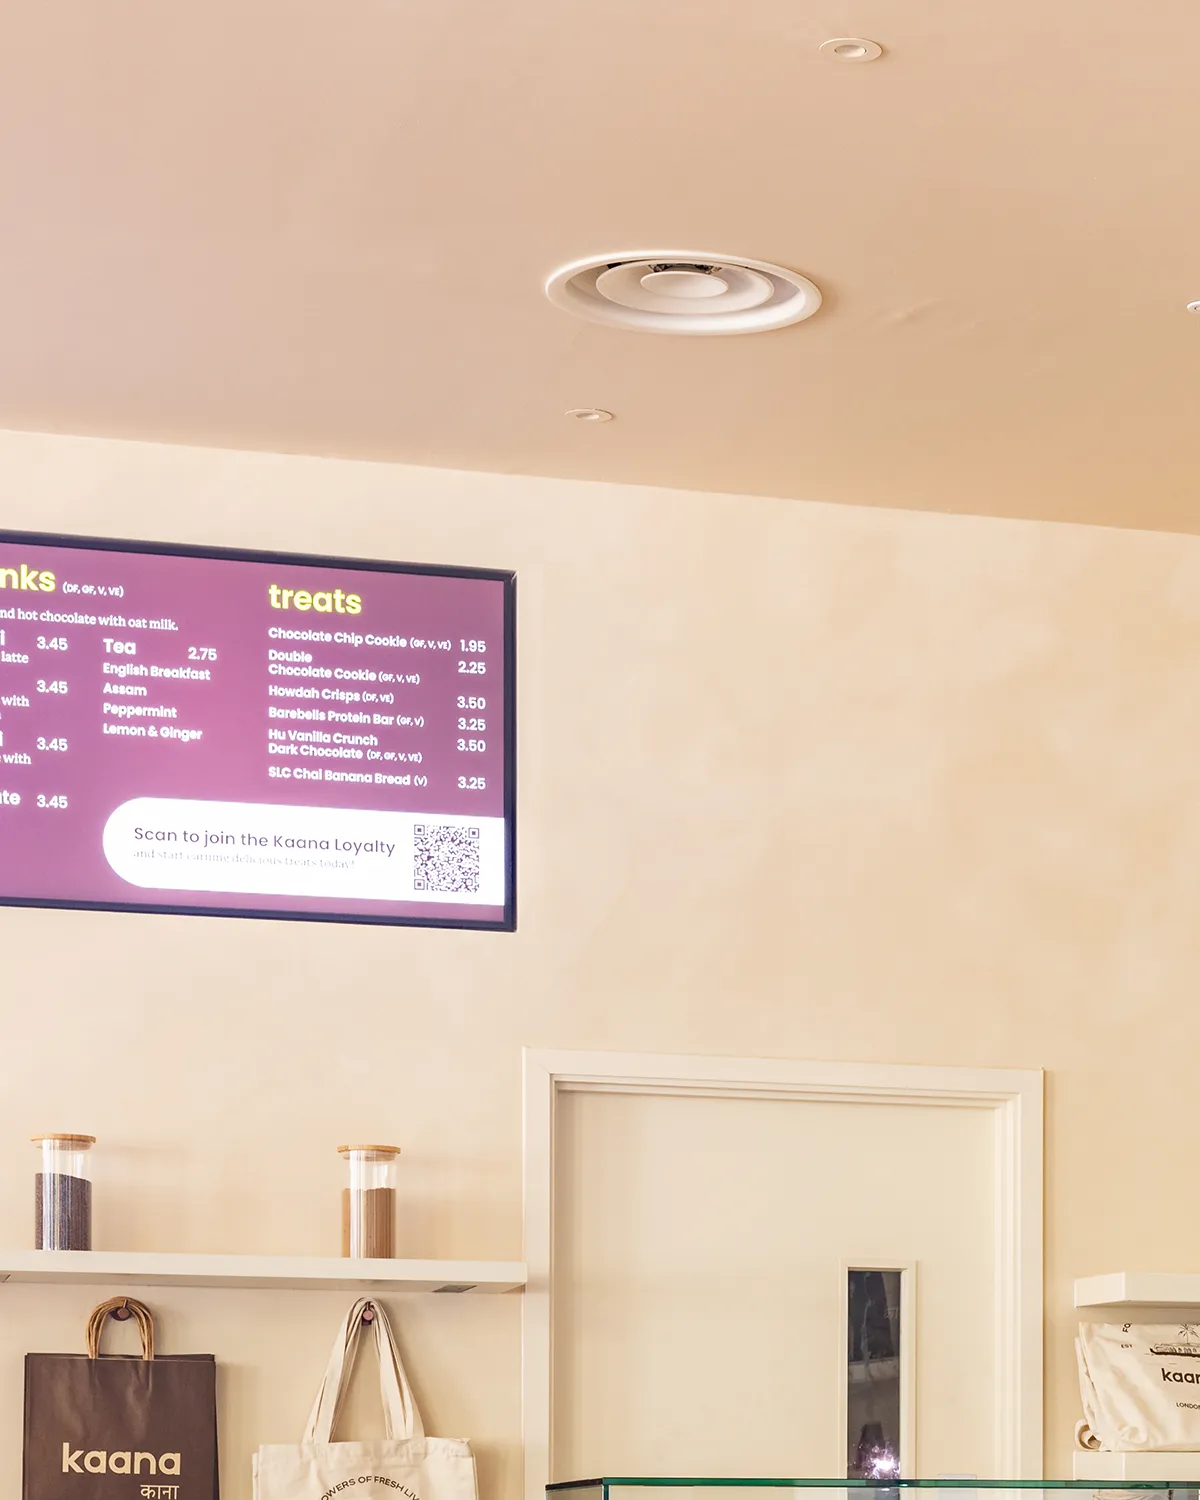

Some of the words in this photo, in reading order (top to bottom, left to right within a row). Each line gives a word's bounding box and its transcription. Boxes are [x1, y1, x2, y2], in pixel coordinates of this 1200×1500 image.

[268, 584, 362, 615] treats
[18, 608, 38, 621] hot
[40, 610, 96, 626] chocolate
[98, 614, 126, 628] with
[128, 617, 148, 629] oat
[150, 618, 178, 631] milk.
[36, 636, 68, 651] 3.45
[268, 626, 332, 642] Chocolate
[334, 632, 364, 647] Chip
[365, 634, 408, 648] Cookie
[460, 639, 486, 653] 1.95
[1, 650, 29, 664] latte
[103, 638, 136, 655] Tea
[188, 647, 218, 661] 2.75
[268, 648, 312, 663] Double
[458, 660, 486, 675] 2.25
[103, 662, 148, 678] English
[150, 665, 211, 681] Breakfast
[268, 664, 332, 678] Chocolate
[334, 668, 377, 681] Cookie
[36, 680, 68, 694] 3.45
[103, 682, 148, 697] Assam
[1, 694, 30, 707] with
[268, 685, 320, 700] Howdah
[322, 688, 360, 704] Crisps
[456, 696, 486, 710] 3.50
[103, 702, 178, 719] Peppermint
[268, 706, 326, 722] Barebells
[328, 710, 371, 725] Protein
[372, 714, 394, 726] Bar
[458, 718, 486, 732] 3.25
[103, 723, 146, 737] Lemon
[148, 726, 158, 738] &
[160, 726, 203, 742] Ginger
[268, 729, 286, 741] Hu
[288, 730, 331, 744] Vanilla
[332, 732, 378, 746] Crunch
[456, 738, 486, 752] 3.50
[36, 737, 68, 752] 3.45
[268, 742, 298, 756] Dark
[300, 744, 364, 760] Chocolate
[2, 752, 32, 765] with
[268, 766, 292, 779] SLC
[293, 768, 322, 781] Chai
[324, 770, 373, 784] Banana
[374, 773, 411, 786] Bread
[458, 776, 486, 790] 3.25
[36, 794, 68, 809] 3.45
[134, 827, 178, 843] Scan
[183, 830, 200, 844] to
[203, 829, 236, 848] join
[240, 832, 268, 847] the
[273, 835, 330, 851] Kaana
[335, 838, 396, 858] Loyalty
[62, 1442, 181, 1476] kaana
[140, 1484, 180, 1500] काना
[358, 1475, 373, 1484] OF
[374, 1476, 404, 1492] FRESH
